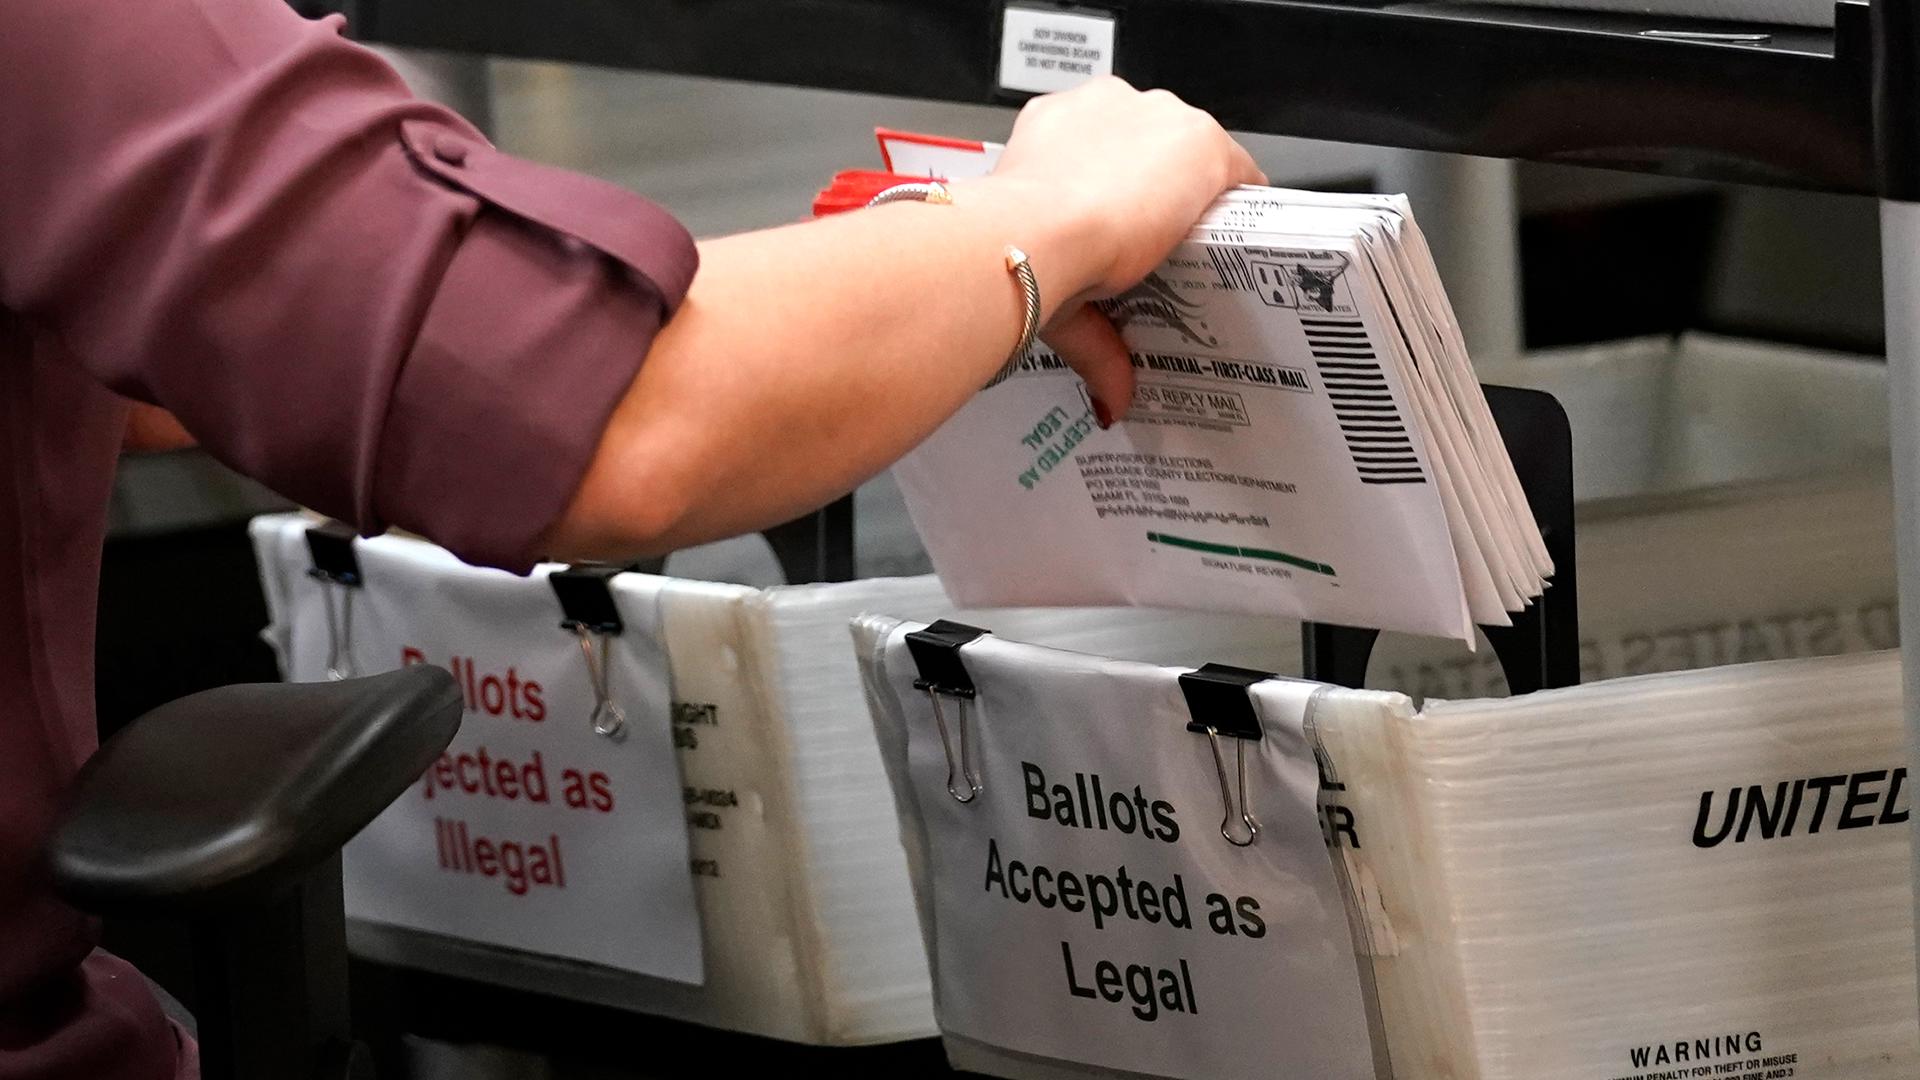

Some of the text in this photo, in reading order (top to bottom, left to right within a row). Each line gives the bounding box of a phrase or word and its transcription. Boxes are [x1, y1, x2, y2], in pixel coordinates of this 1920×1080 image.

[1278, 368, 1308, 389] MAIL
[1161, 388, 1204, 407] REPLY
[1207, 393, 1240, 412] MAIL
[1022, 405, 1069, 451] LEGAL
[1159, 455, 1214, 469] ELECTIONS
[1144, 467, 1183, 479] COUNTY
[1184, 470, 1237, 485] ELECTIONS
[1239, 476, 1297, 493] DEPARTMENT
[1201, 556, 1292, 578] SIGNATURE REVIEW
[561, 768, 615, 812] as
[1021, 761, 1181, 843] Ballots
[434, 816, 566, 896] Illegal
[984, 838, 1268, 939] Accepted as
[1061, 941, 1199, 1022] Legal
[1630, 1031, 1763, 1068] WARNING
[1692, 1065, 1711, 1077] FOR
[1714, 1061, 1744, 1075] THEFT
[1746, 1059, 1760, 1070] OR
[1762, 1053, 1798, 1067] MISUSE
[1766, 1069, 1786, 1080] AND
